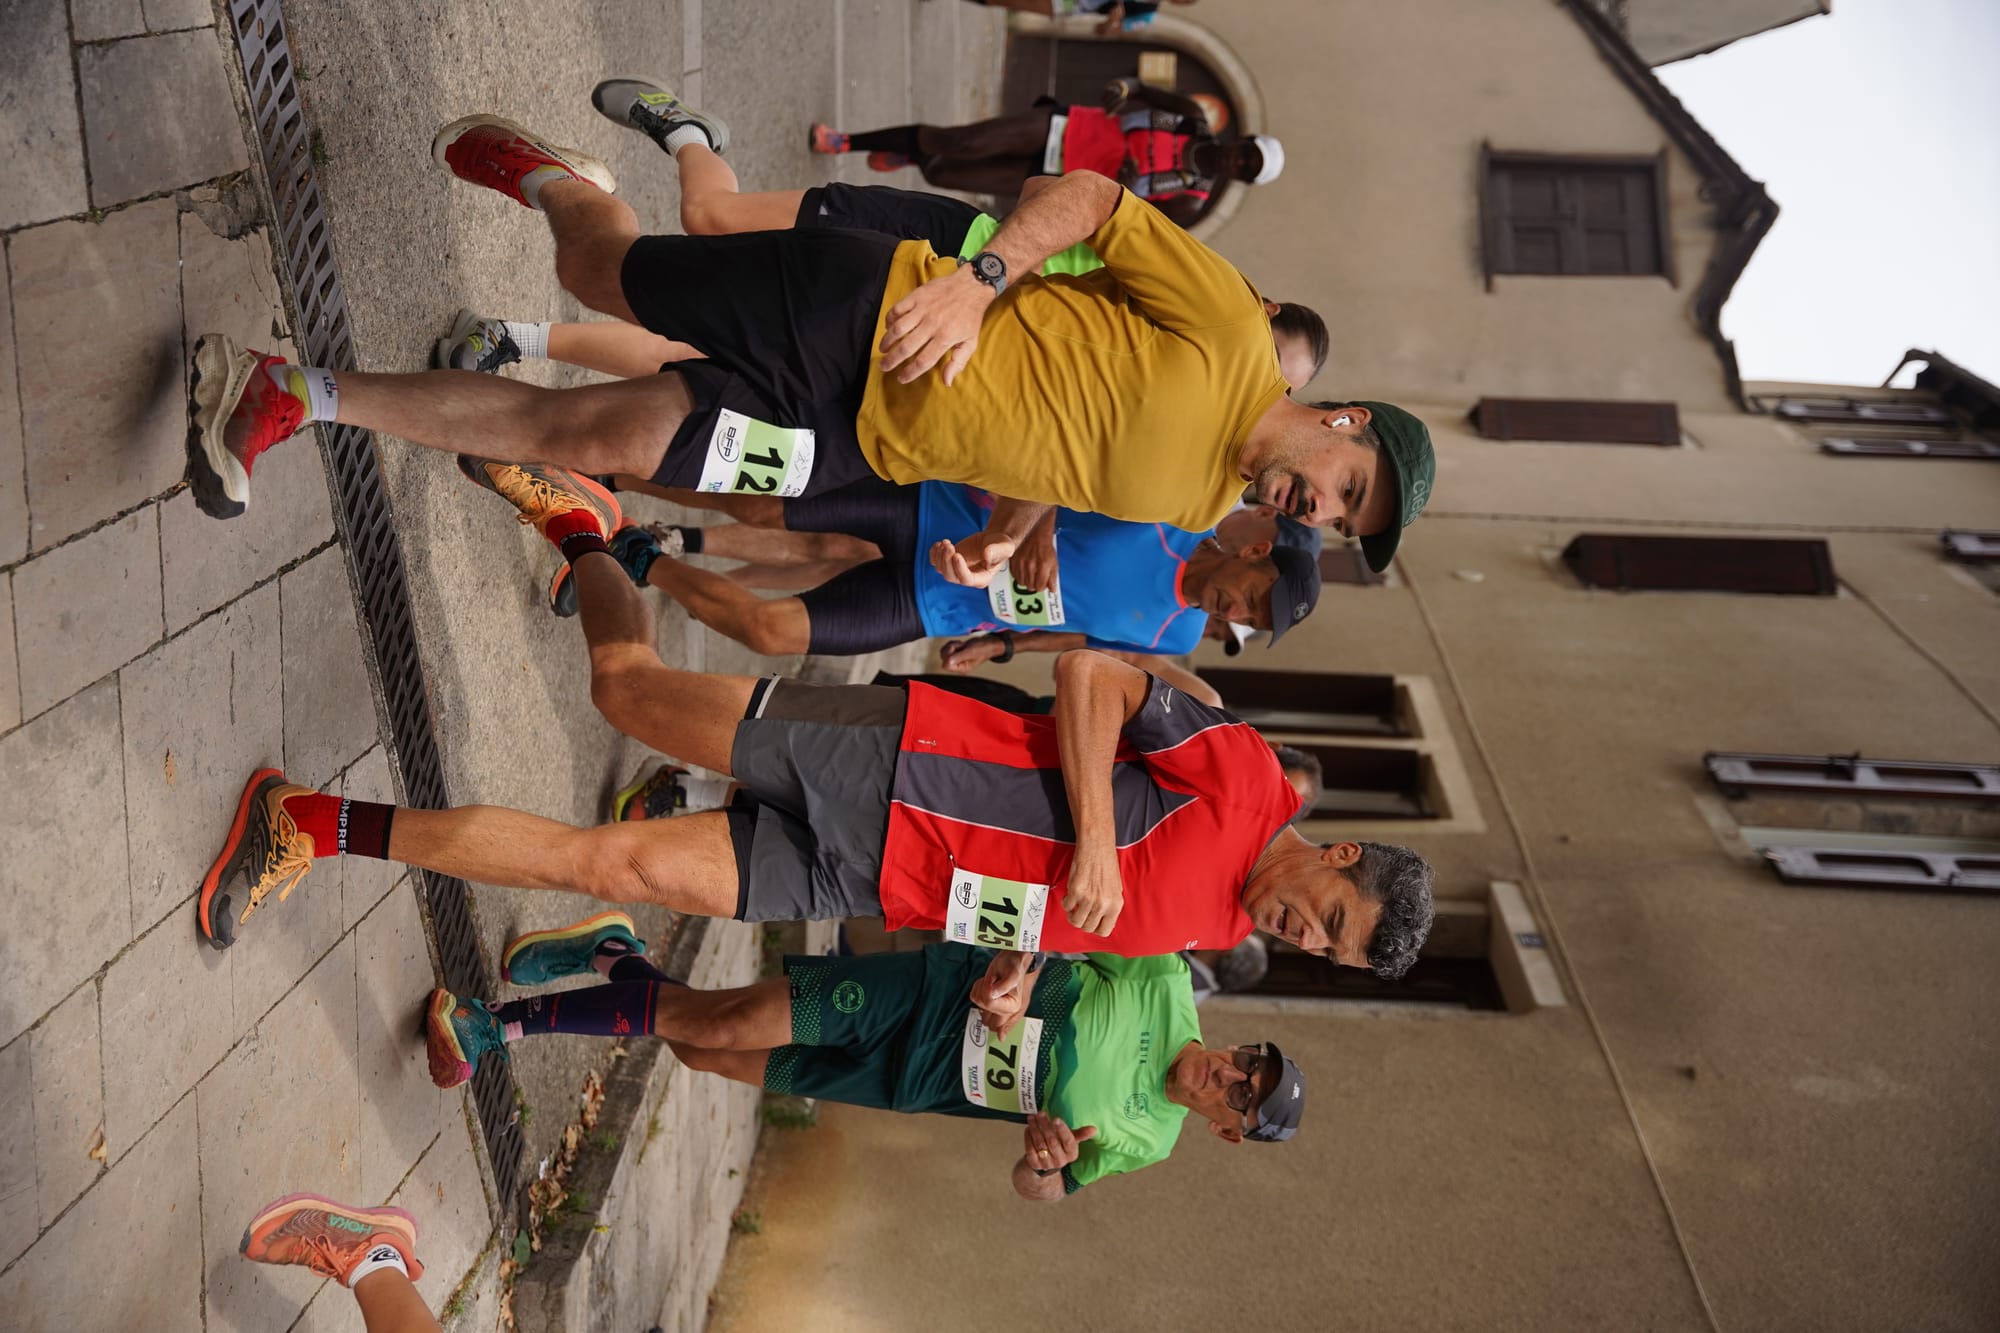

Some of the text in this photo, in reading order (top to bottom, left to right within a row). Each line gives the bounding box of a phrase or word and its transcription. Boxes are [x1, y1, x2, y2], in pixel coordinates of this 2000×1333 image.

[722, 427, 737, 457] BFP
[735, 447, 785, 496] 12
[962, 882, 972, 905] BFP
[977, 897, 1019, 947] 125
[987, 1044, 1017, 1091] 79
[328, 1215, 374, 1233] HOKA
